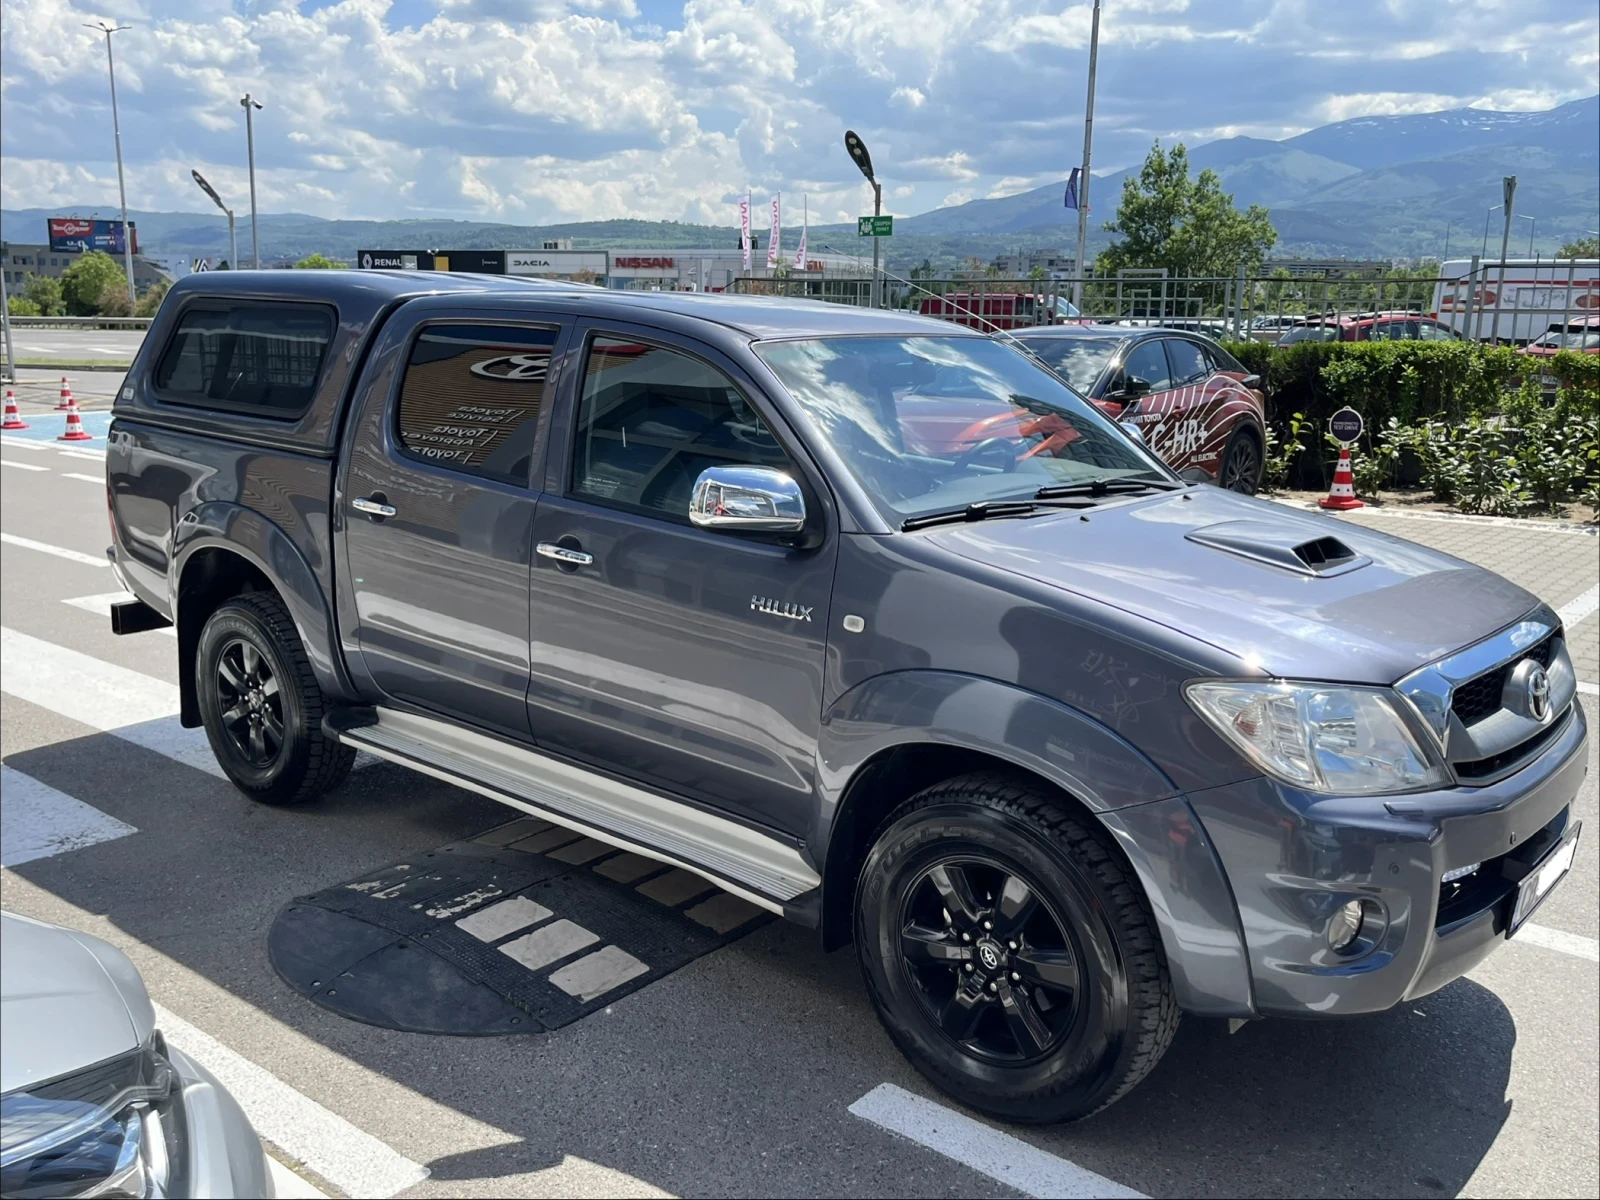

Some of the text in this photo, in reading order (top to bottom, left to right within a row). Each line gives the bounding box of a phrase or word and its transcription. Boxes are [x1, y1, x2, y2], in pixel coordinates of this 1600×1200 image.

[375, 258, 402, 266] RENAU
[615, 257, 673, 268] NISSAN
[1151, 419, 1208, 460] C-HR+
[1198, 452, 1217, 462] ELECTRIC
[751, 594, 813, 622] HILUX
